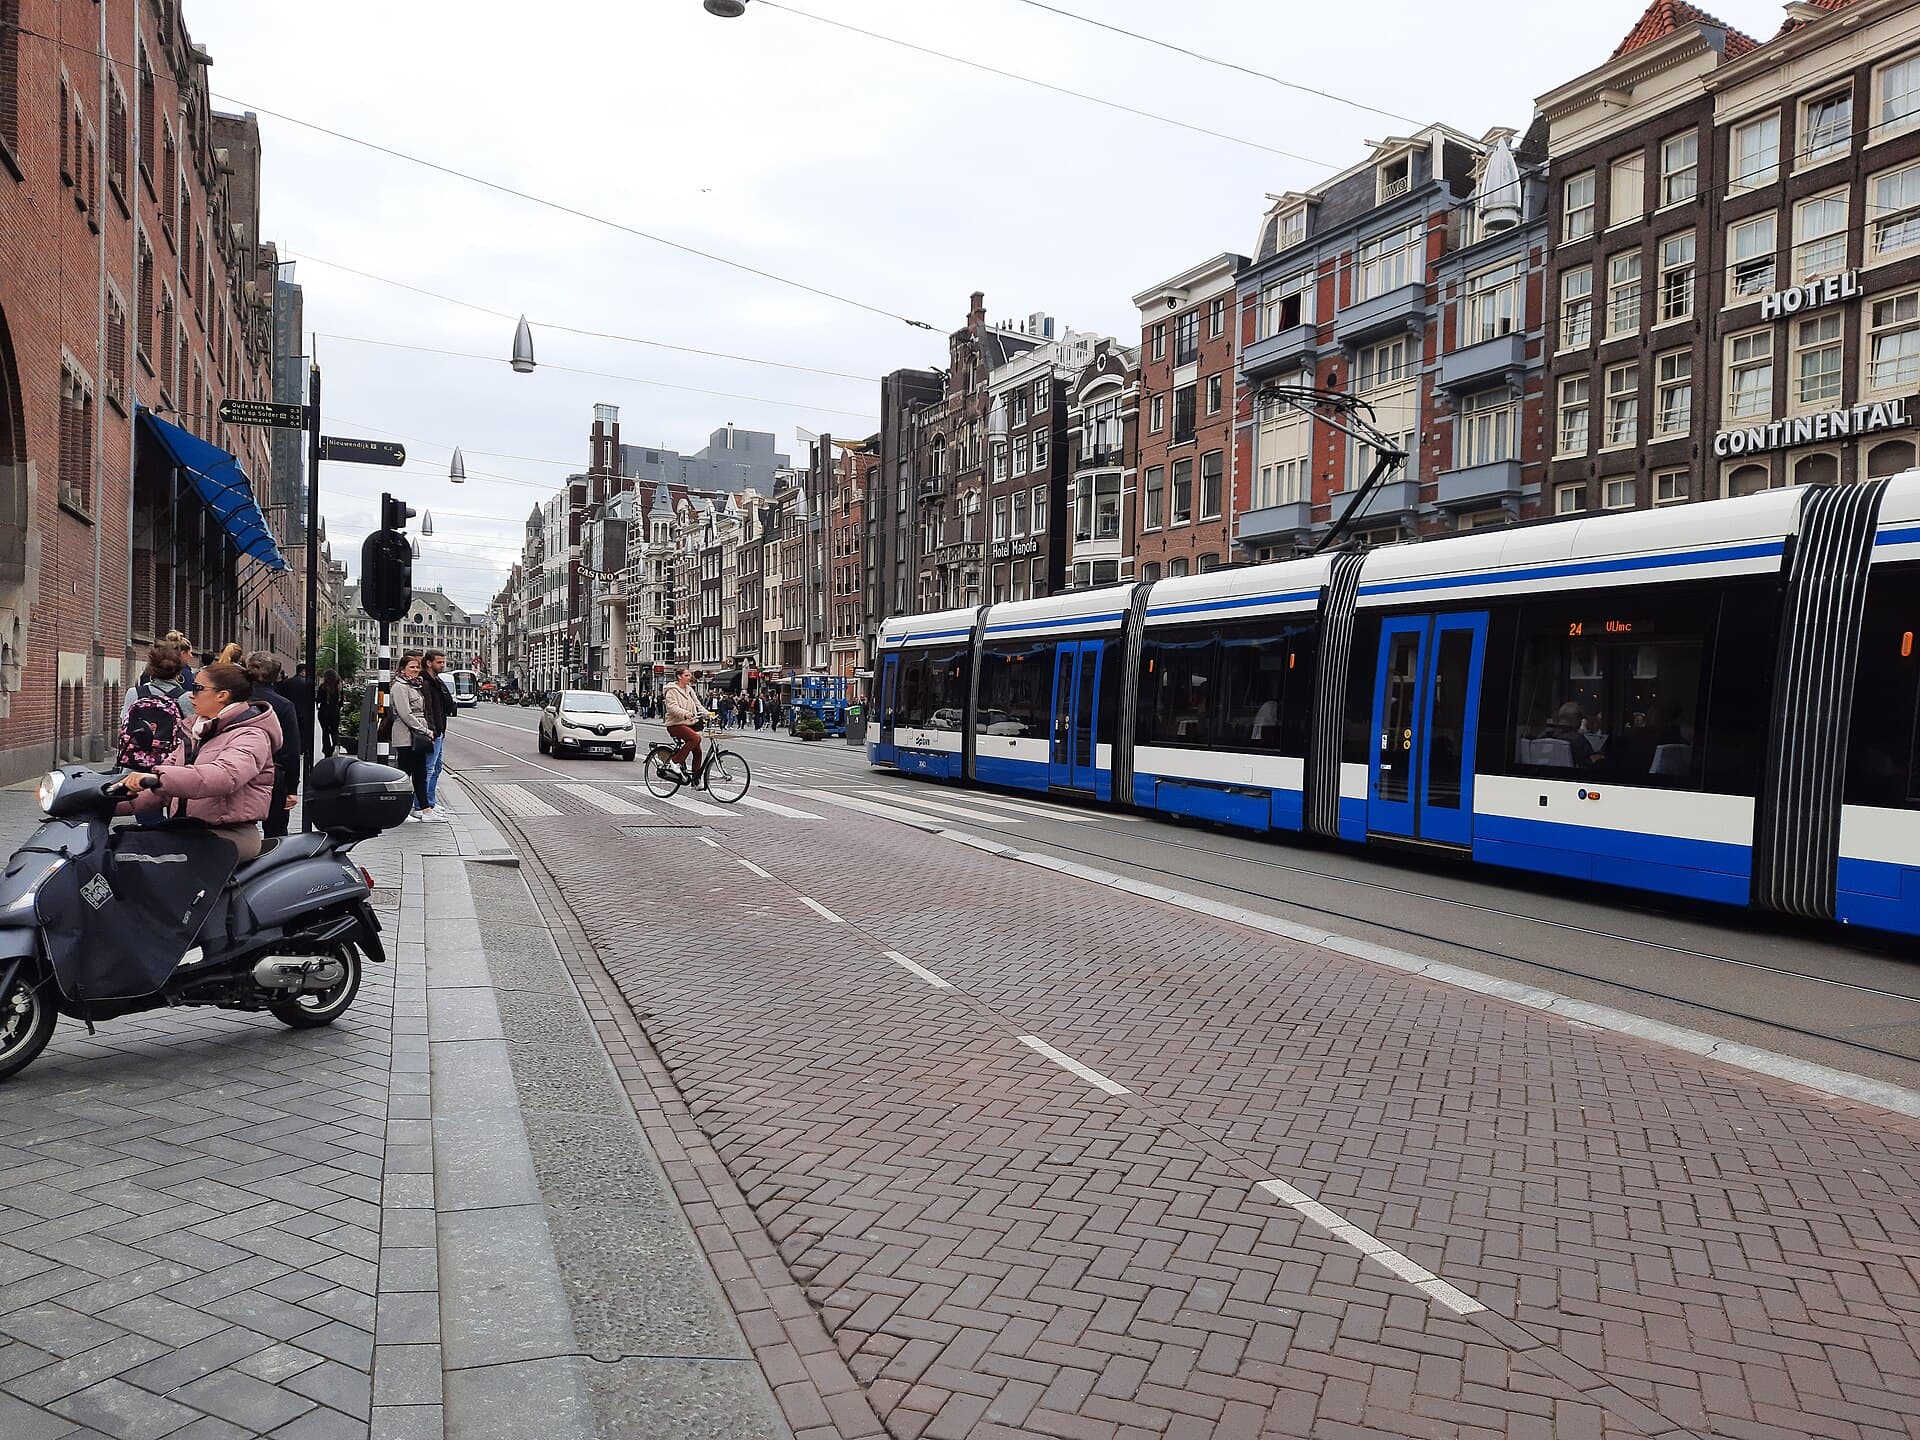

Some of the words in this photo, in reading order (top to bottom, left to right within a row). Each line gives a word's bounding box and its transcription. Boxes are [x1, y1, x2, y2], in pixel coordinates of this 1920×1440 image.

[1761, 270, 1859, 321] HOTEL
[231, 415, 273, 424] Nieuwmarkt
[1714, 399, 1908, 456] CONTINENTAL
[329, 439, 370, 449] Nieuwendijk
[992, 542, 1010, 559] Hotel
[577, 566, 614, 581] CASINO
[1569, 622, 1582, 636] 24
